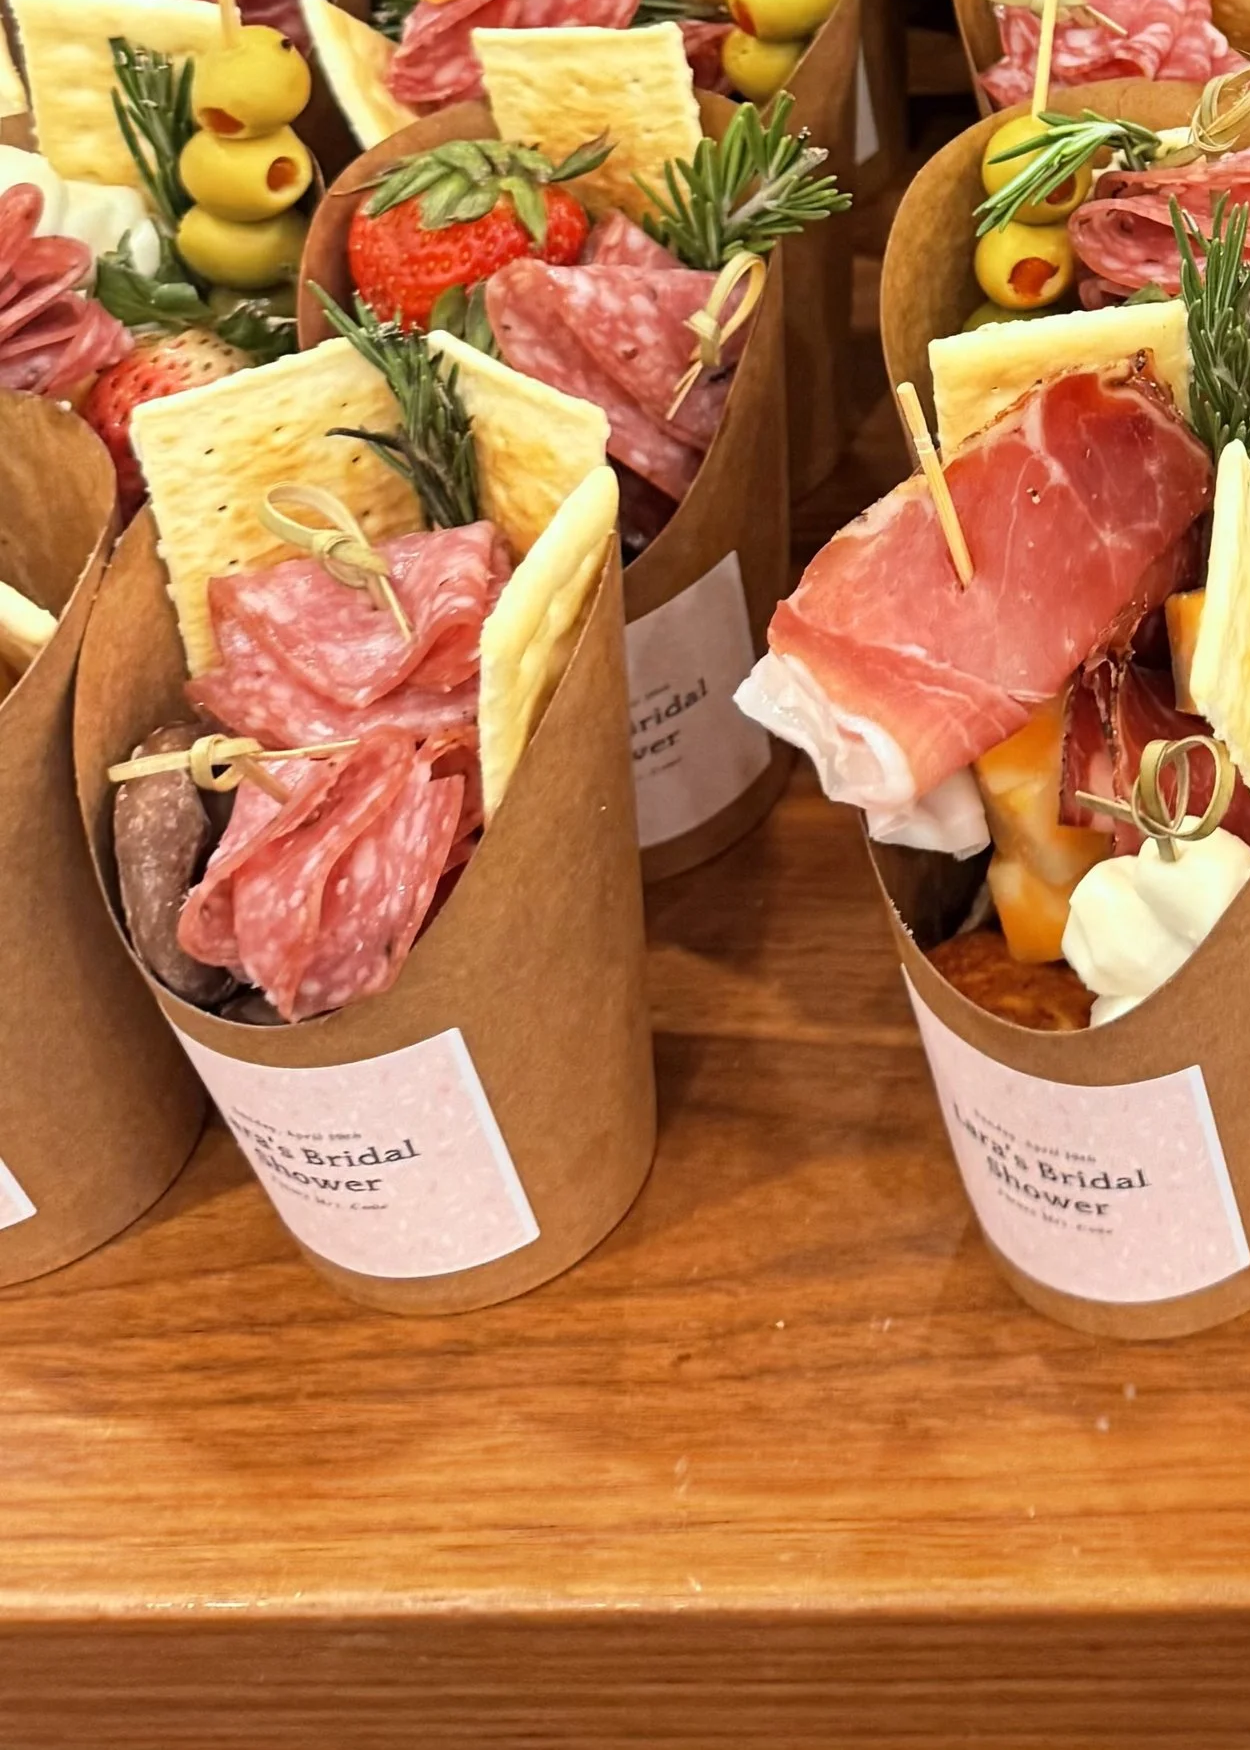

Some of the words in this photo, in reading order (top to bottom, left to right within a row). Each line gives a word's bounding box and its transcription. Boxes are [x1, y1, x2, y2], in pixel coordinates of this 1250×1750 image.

[301, 1139, 421, 1167] Bridal
[953, 1101, 1029, 1172] Lara's
[1037, 1160, 1151, 1191] Bridal
[987, 1155, 1111, 1216] Shower
